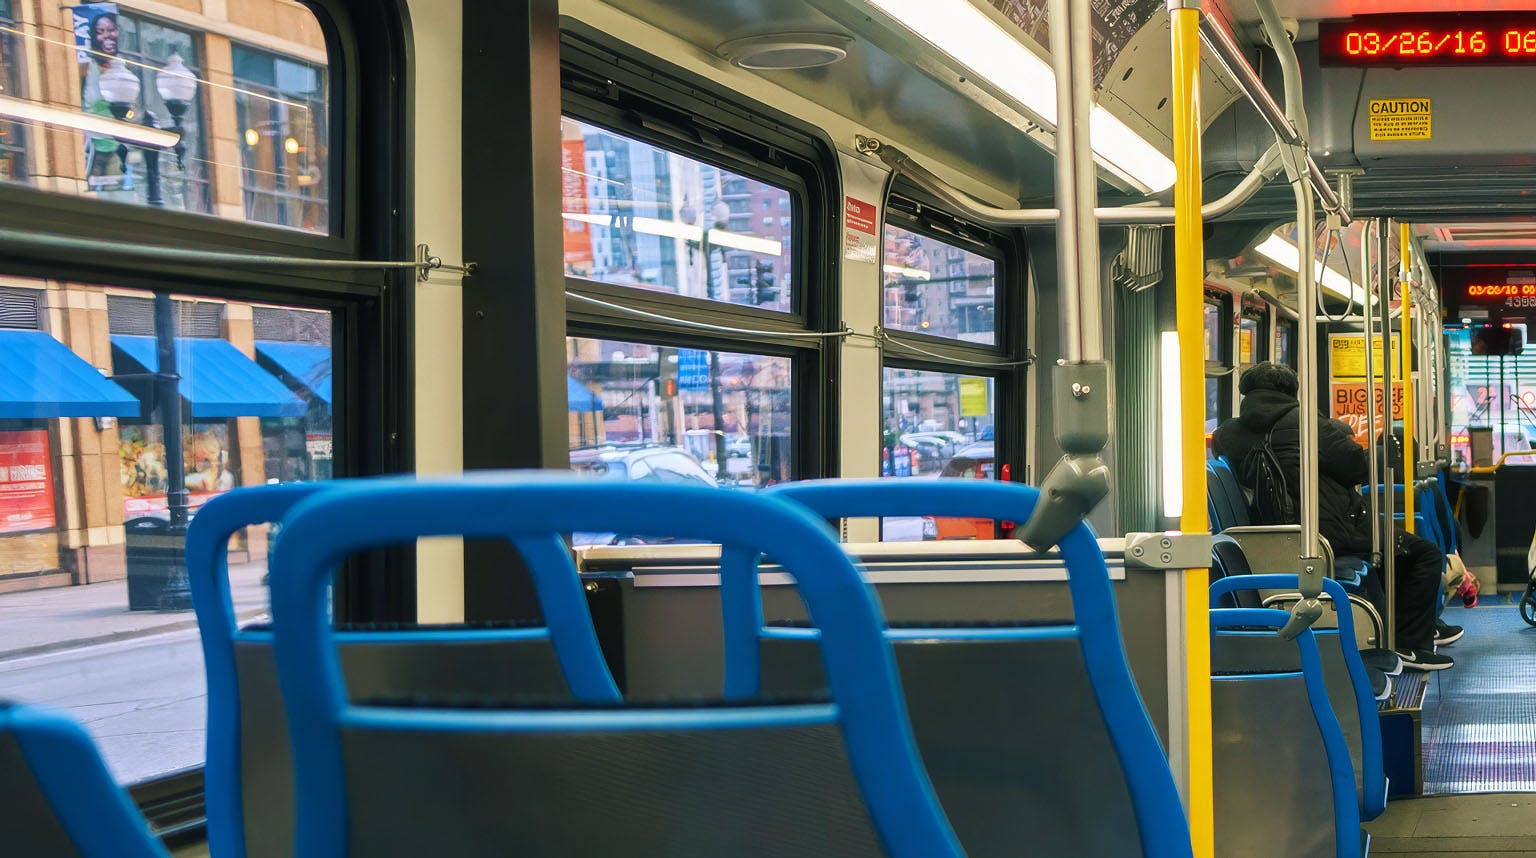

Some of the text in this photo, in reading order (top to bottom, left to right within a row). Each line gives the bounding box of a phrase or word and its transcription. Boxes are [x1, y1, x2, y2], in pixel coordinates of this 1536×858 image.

[73, 14, 92, 64] PLAY
[1346, 31, 1487, 54] 03/26/16
[1371, 101, 1429, 114] CAUTION
[1336, 403, 1366, 417] JUS
